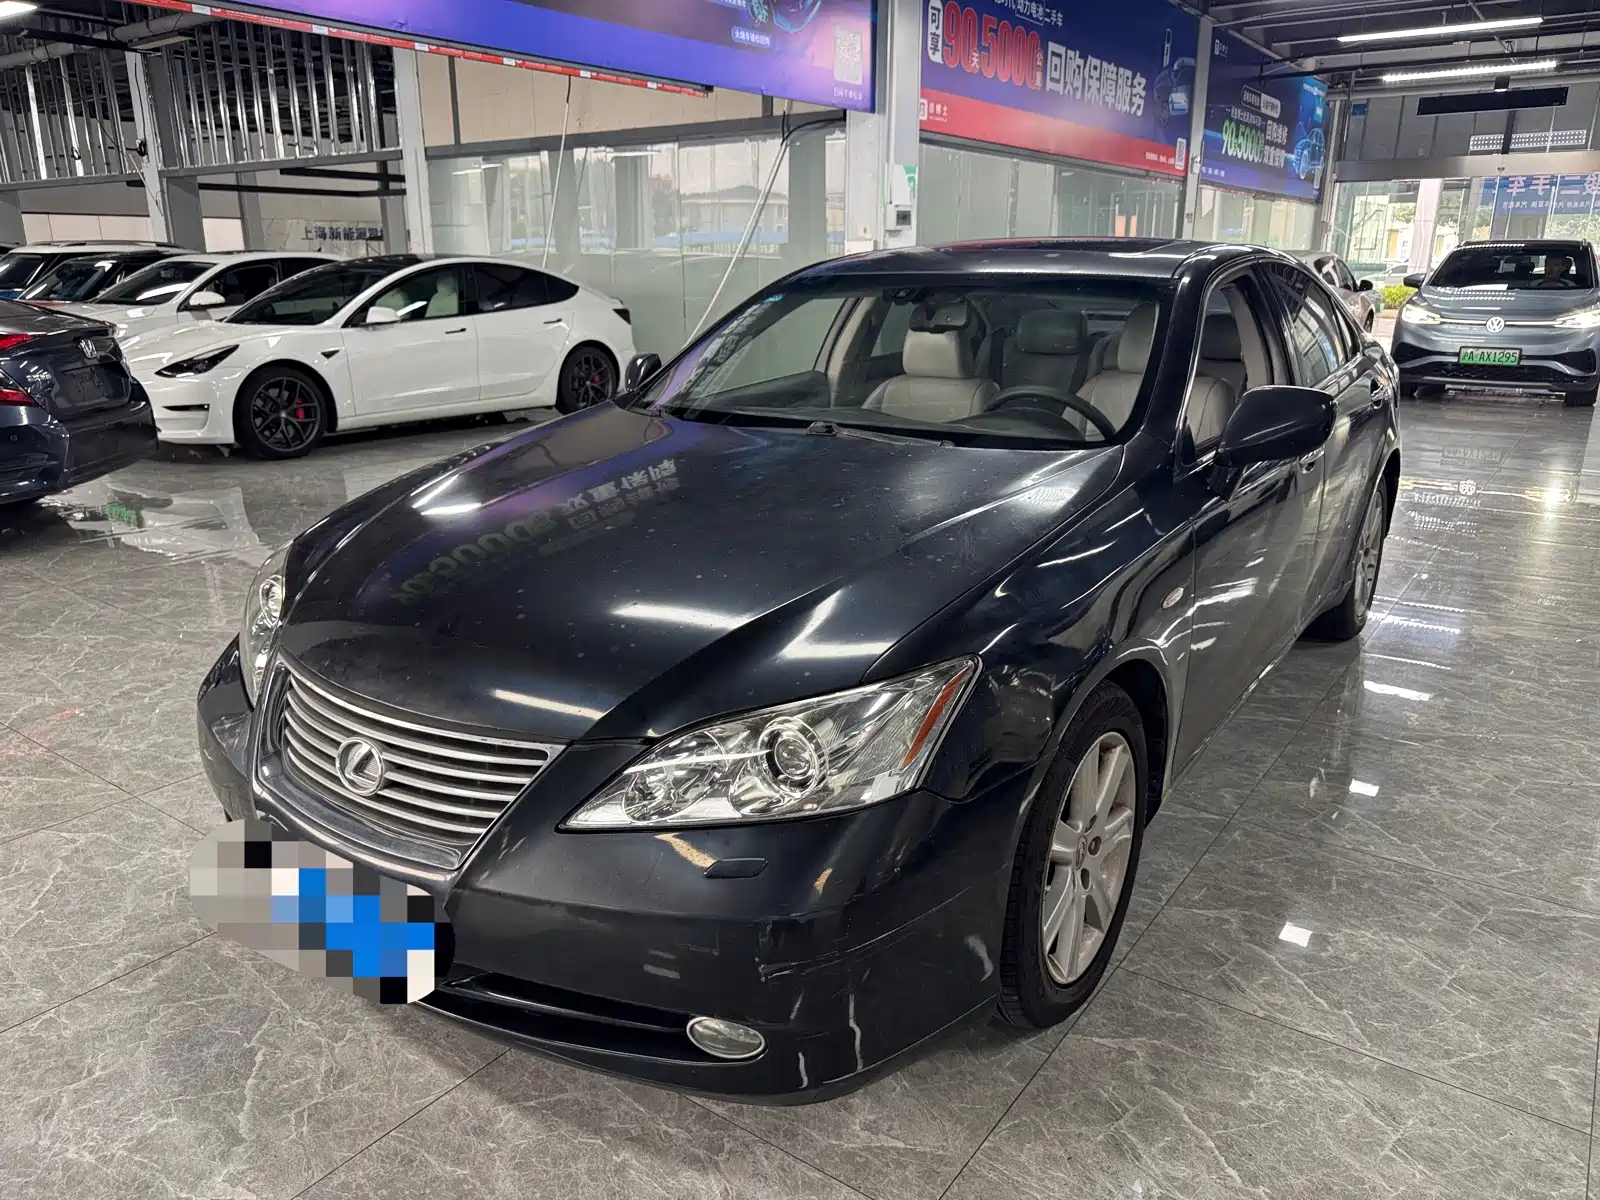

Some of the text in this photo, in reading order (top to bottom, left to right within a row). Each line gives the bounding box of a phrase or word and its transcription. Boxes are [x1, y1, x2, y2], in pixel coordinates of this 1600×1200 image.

[930, 6, 941, 55] 可享
[1046, 41, 1147, 117] 回购保障服务
